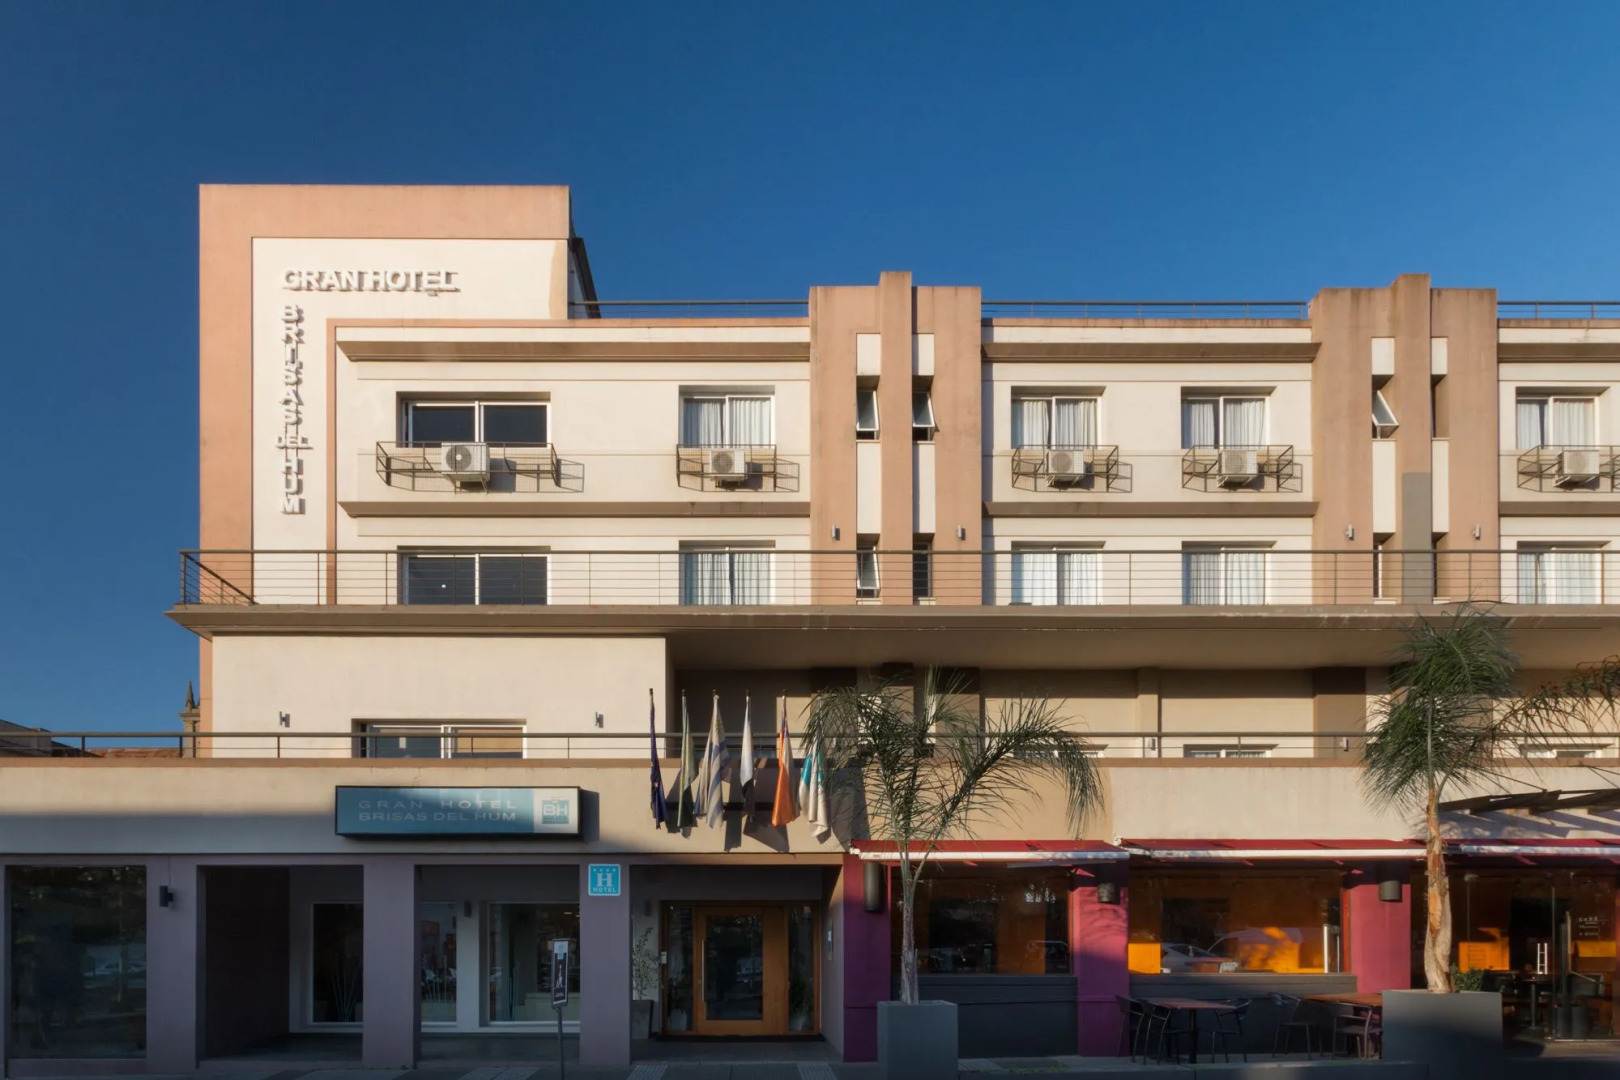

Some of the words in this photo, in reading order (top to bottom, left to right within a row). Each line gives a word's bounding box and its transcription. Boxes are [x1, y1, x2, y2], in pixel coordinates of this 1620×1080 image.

[284, 270, 361, 291] GRAN
[365, 270, 458, 292] HOTEL
[280, 303, 303, 425] BRISAS
[276, 434, 311, 449] DEL
[280, 456, 303, 514] HUM
[358, 800, 423, 809] GRAN
[441, 800, 517, 809] HOTEL
[543, 804, 568, 816] BH
[358, 812, 427, 821] BRISAS
[433, 812, 469, 821] DEL
[474, 812, 516, 821] HUM
[596, 872, 612, 887] H
